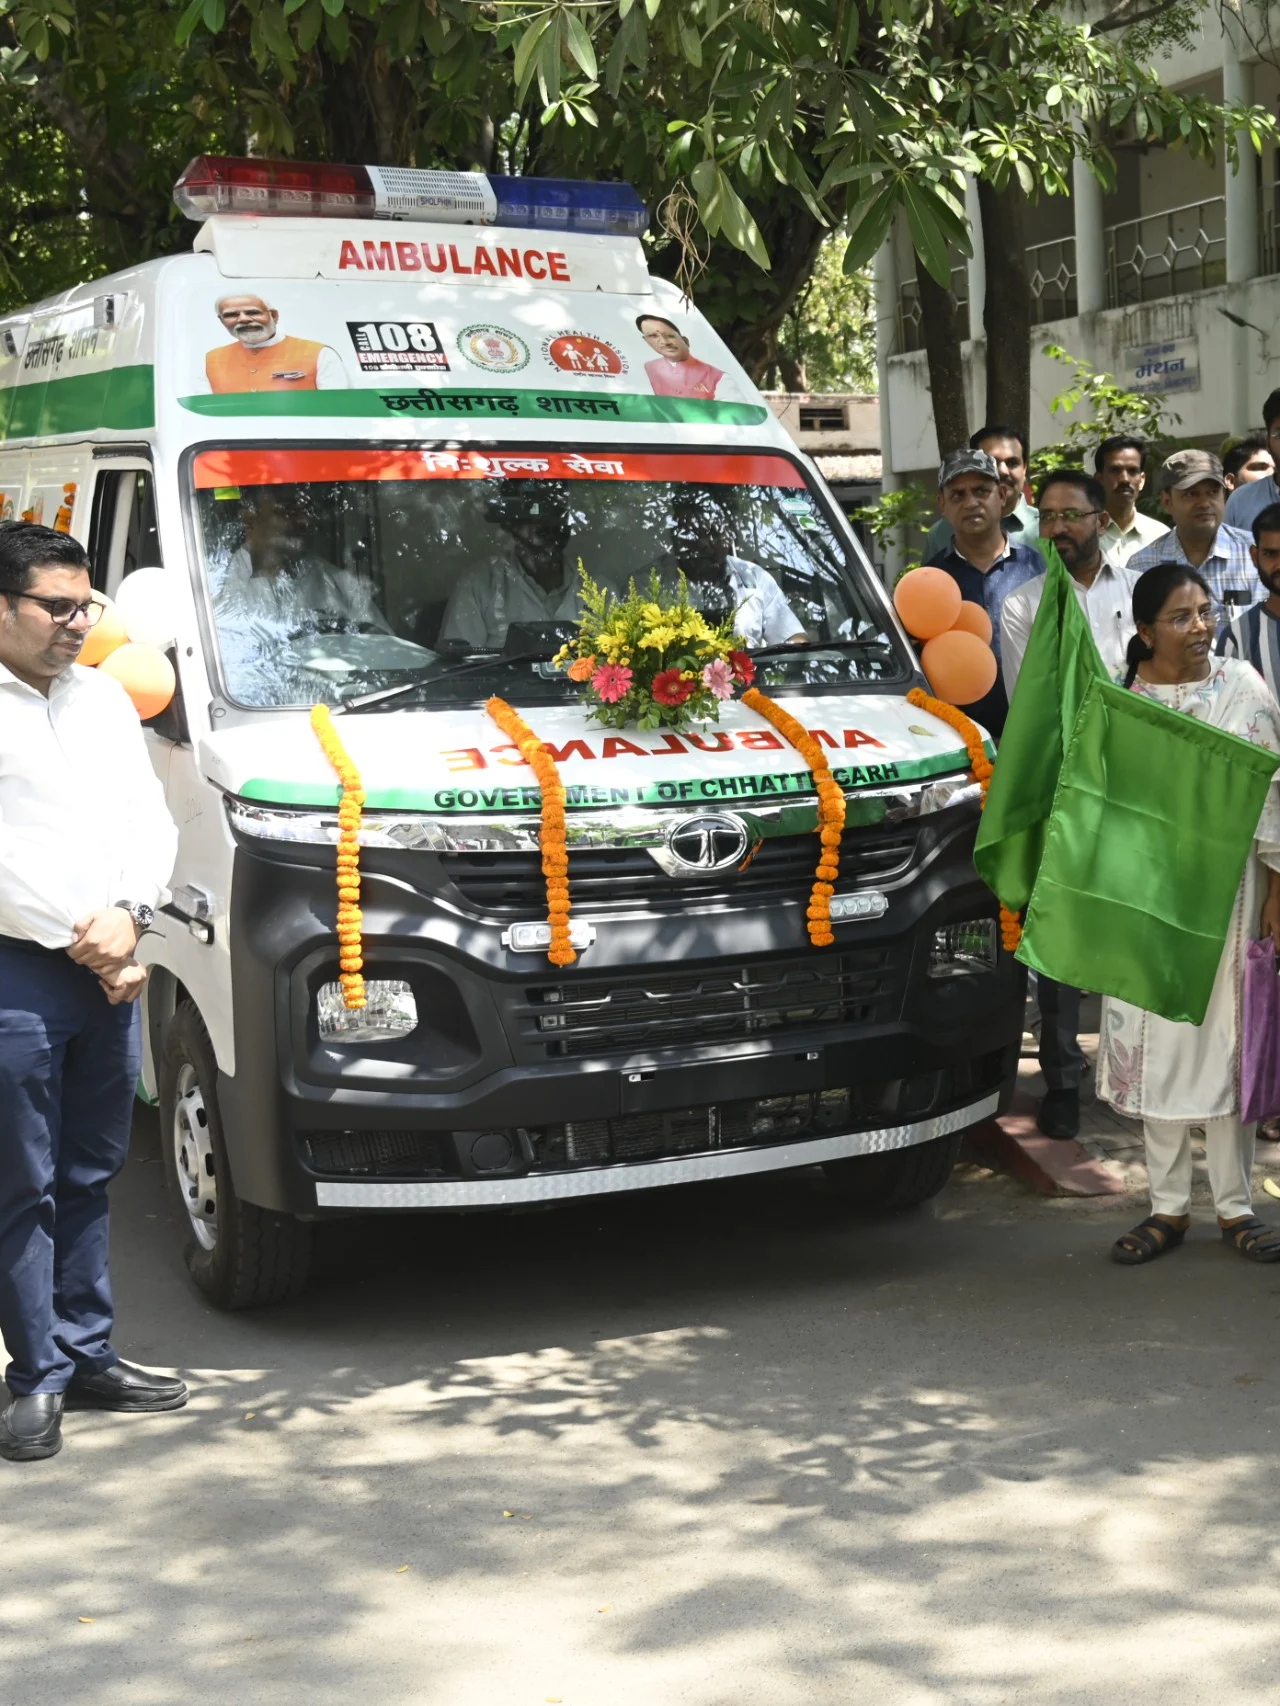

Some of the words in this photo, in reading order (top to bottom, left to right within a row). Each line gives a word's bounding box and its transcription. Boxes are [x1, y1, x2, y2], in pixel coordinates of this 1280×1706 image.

[338, 240, 571, 282] AMBULANCE
[357, 323, 438, 352] 108
[358, 352, 445, 363] EMERGENCY
[541, 334, 562, 373] NATIONAL
[557, 330, 600, 340] HEALTH
[1134, 357, 1186, 378] मंथन
[535, 396, 621, 415] शासन
[562, 453, 625, 475] सेवा
[434, 786, 647, 809] GOVERMENT
[657, 781, 694, 801] OF
[700, 763, 900, 798] CHHATTIGARH
